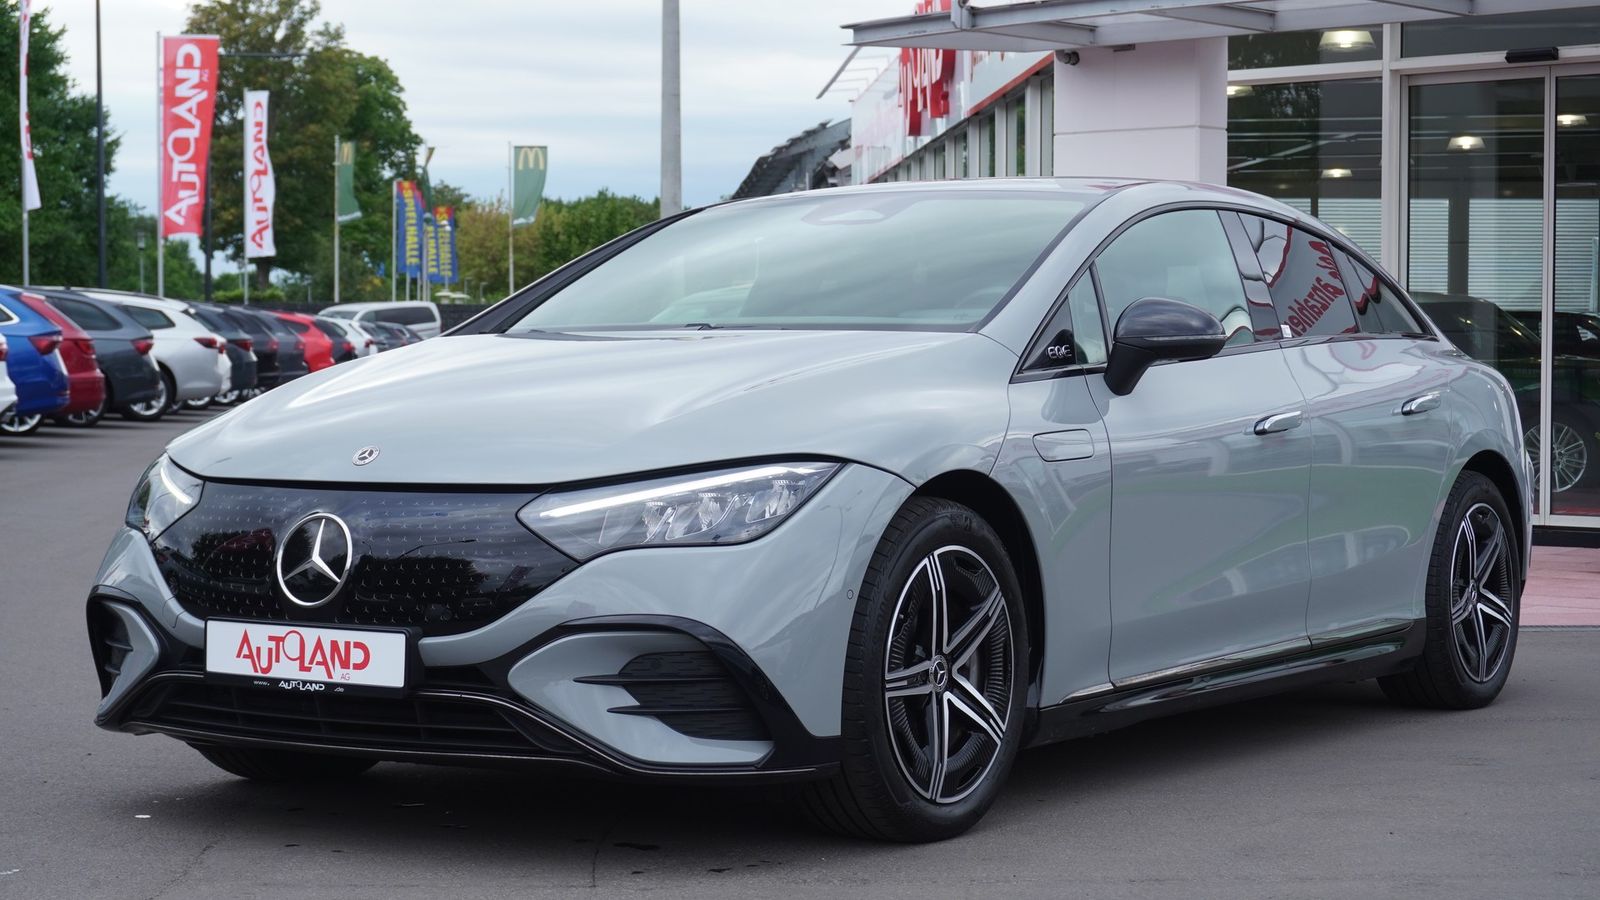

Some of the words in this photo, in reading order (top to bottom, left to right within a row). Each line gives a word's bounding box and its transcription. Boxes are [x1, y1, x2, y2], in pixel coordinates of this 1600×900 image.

[164, 43, 208, 226] AUTOLAND
[250, 100, 270, 249] AUTOLAND
[403, 189, 420, 266] SPIELHALLE
[1047, 344, 1072, 359] EQE
[236, 628, 370, 680] AUTOLAND
[340, 672, 351, 681] AG
[278, 680, 325, 692] AUTOLAND
